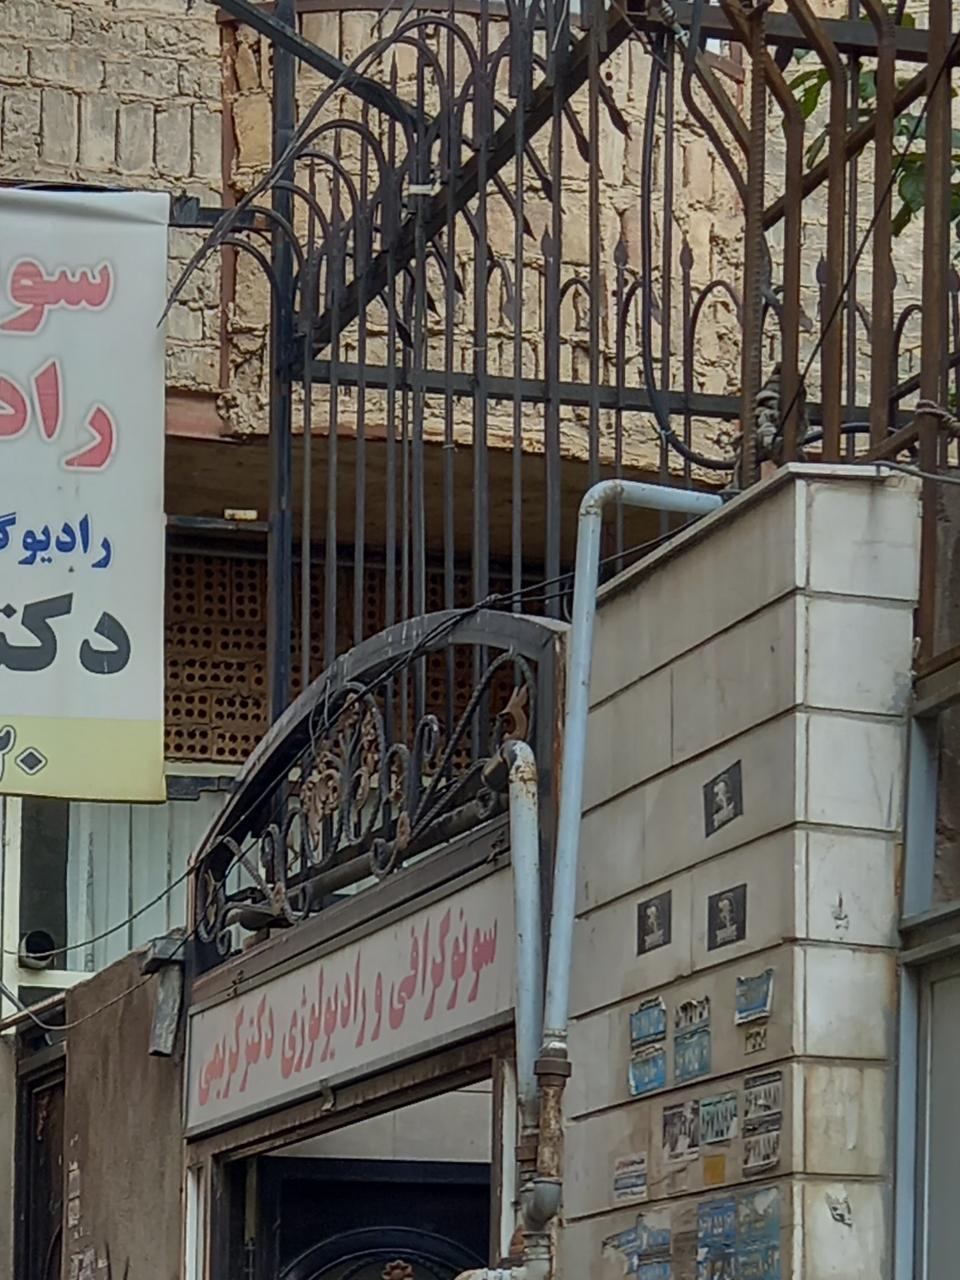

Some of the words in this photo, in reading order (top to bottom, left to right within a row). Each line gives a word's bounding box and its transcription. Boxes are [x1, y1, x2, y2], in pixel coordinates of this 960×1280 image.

[198, 1004, 245, 1107] کریمی
[239, 993, 275, 1092] دکتر
[280, 949, 367, 1080] رادیولوژی
[371, 970, 384, 1042] و
